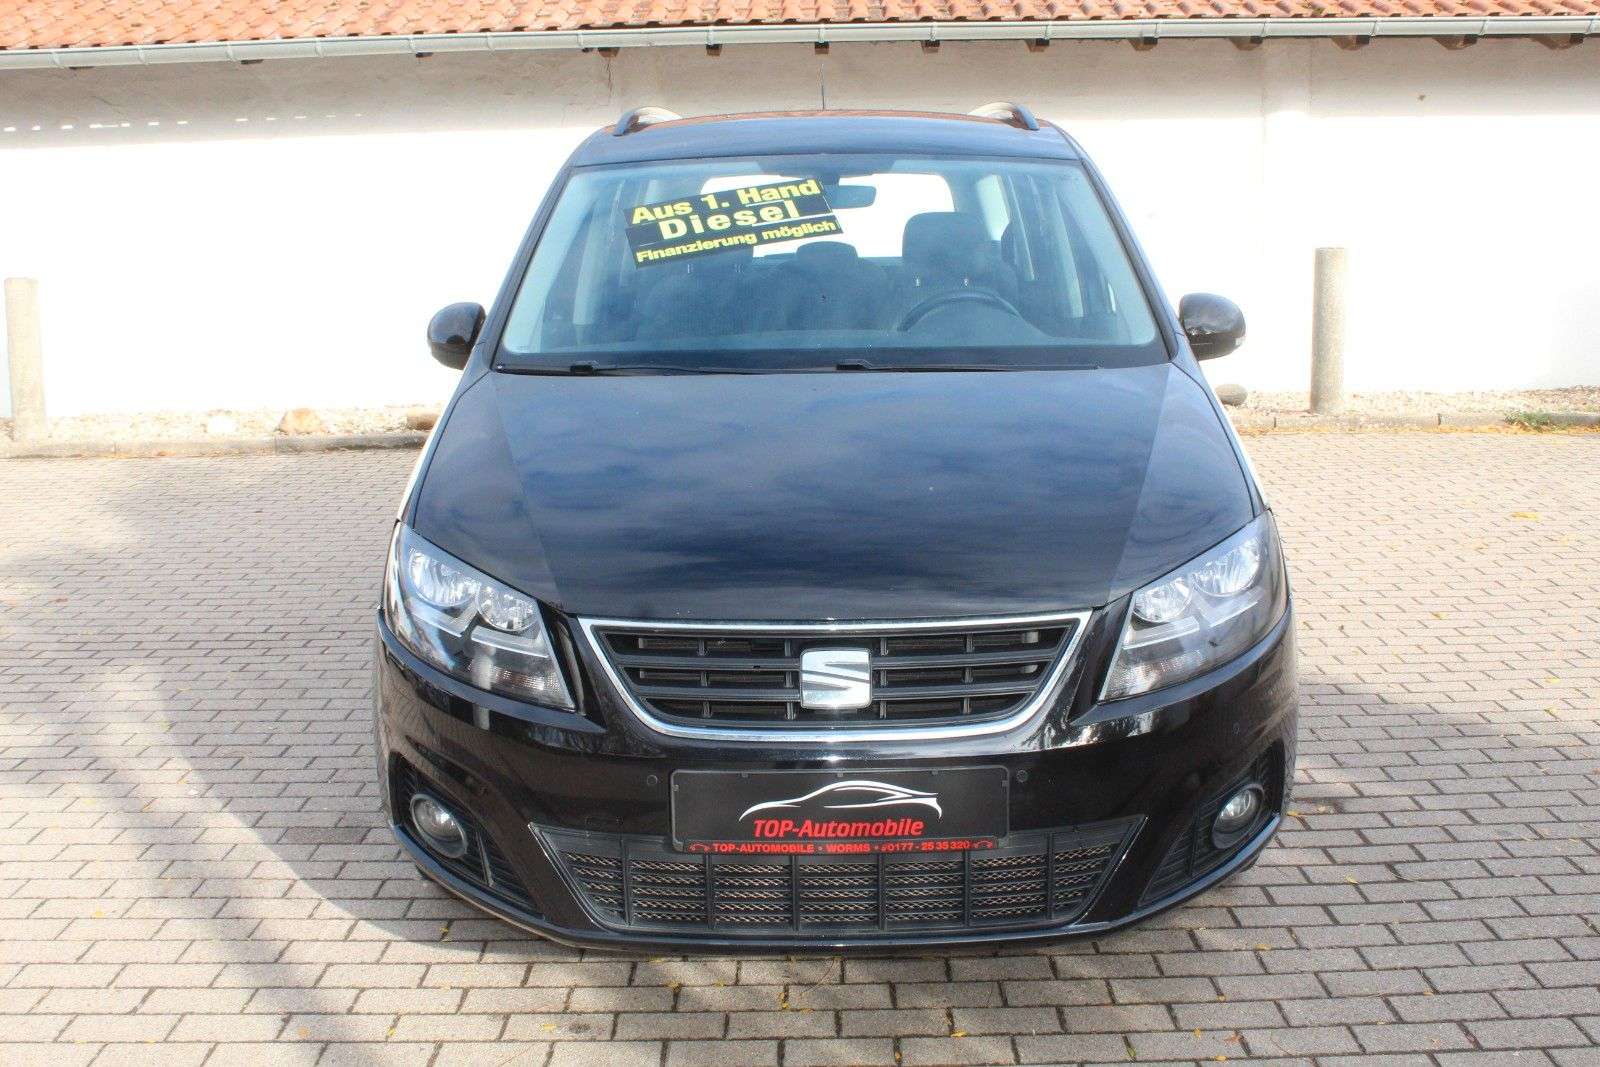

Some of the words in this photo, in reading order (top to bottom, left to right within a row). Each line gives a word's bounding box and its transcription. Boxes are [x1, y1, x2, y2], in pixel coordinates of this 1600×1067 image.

[632, 200, 693, 224] Aus
[700, 194, 730, 210] 1.
[736, 179, 821, 204] Hand
[657, 200, 800, 240] Diesel
[636, 232, 758, 262] Finanzierung
[761, 220, 837, 240] möglich
[753, 818, 924, 837] TOP-Automobile
[712, 844, 814, 853] TOP-AUTOMOBILE
[826, 843, 870, 853] WORMS
